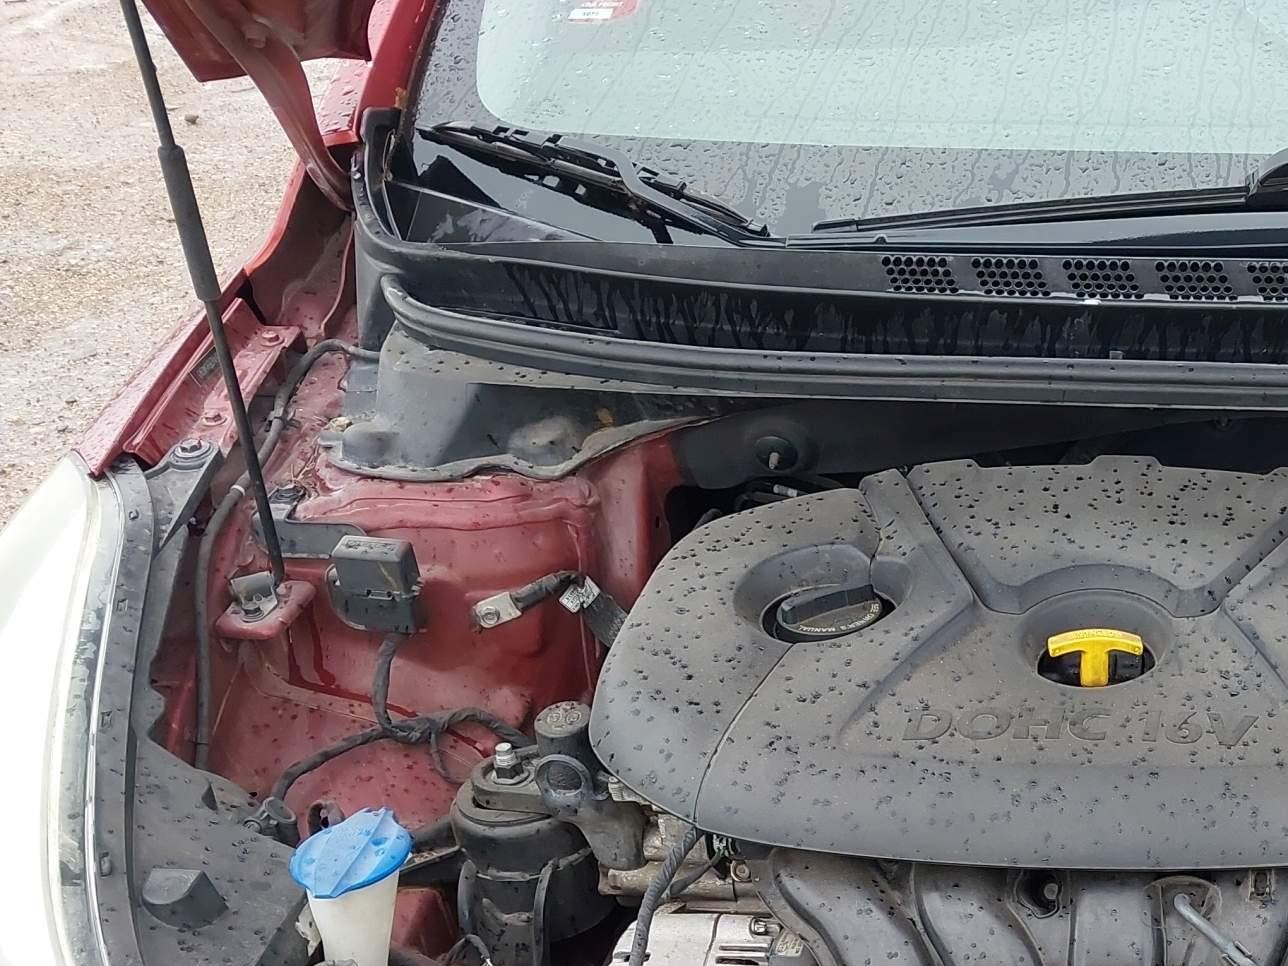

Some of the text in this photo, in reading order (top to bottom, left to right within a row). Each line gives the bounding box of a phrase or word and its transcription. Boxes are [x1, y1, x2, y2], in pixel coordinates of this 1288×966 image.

[798, 624, 837, 633] MANUAL
[901, 708, 1260, 747] DOHC 16V
